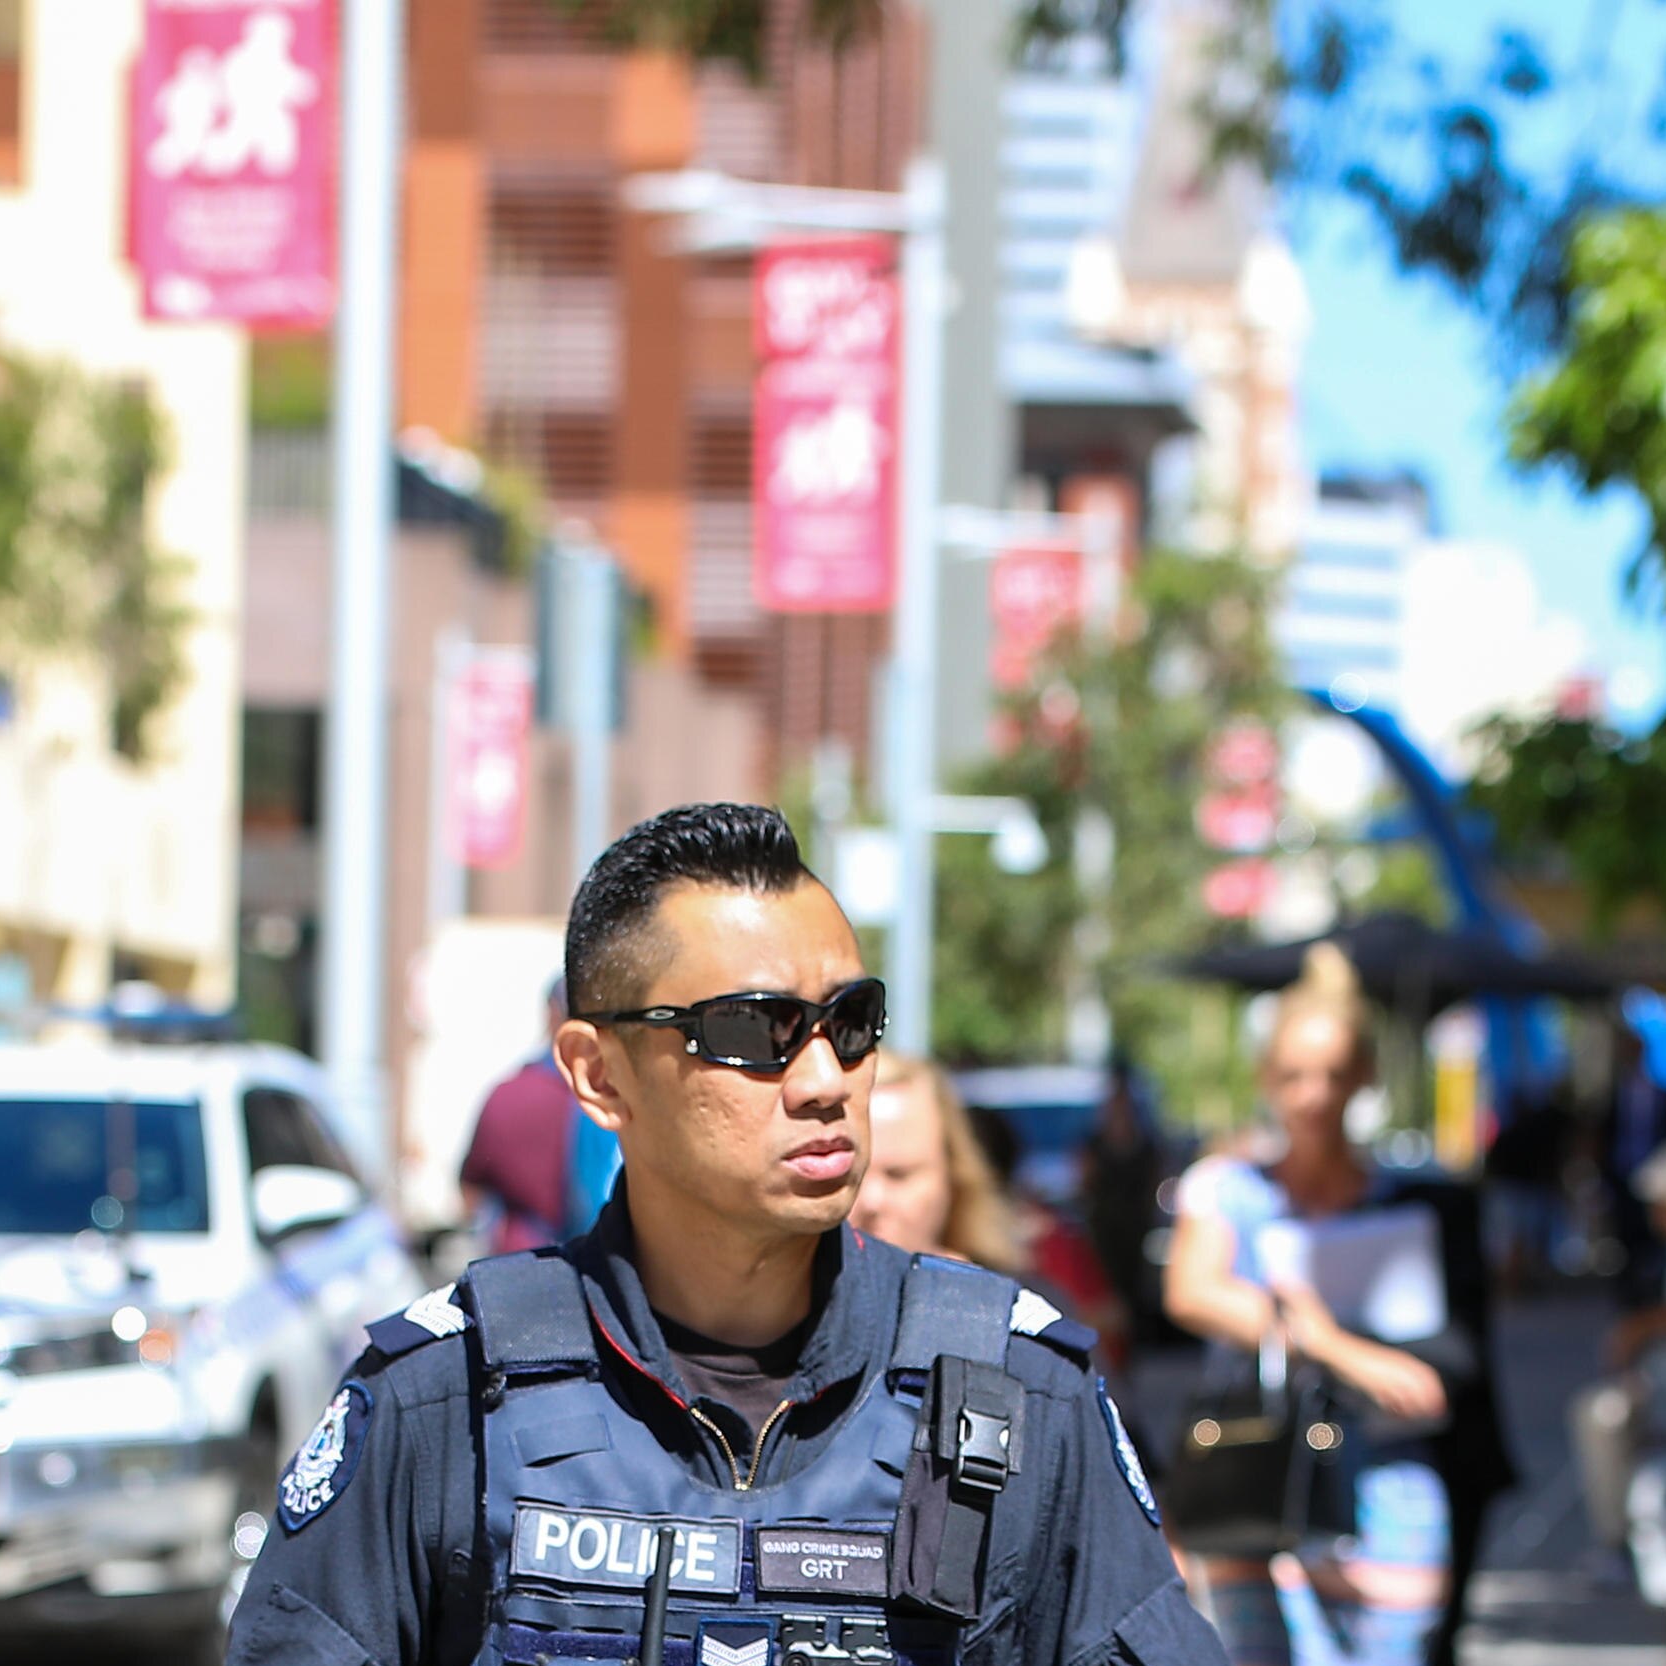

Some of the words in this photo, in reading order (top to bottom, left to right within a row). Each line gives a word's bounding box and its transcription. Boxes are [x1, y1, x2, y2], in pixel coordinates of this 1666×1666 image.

[282, 1473, 335, 1515] POLICE
[535, 1512, 718, 1582] POLICE
[763, 1541, 800, 1554] GANG
[801, 1542, 839, 1556] CRIME
[841, 1544, 884, 1559] SQUAD
[800, 1558, 849, 1580] GRT
